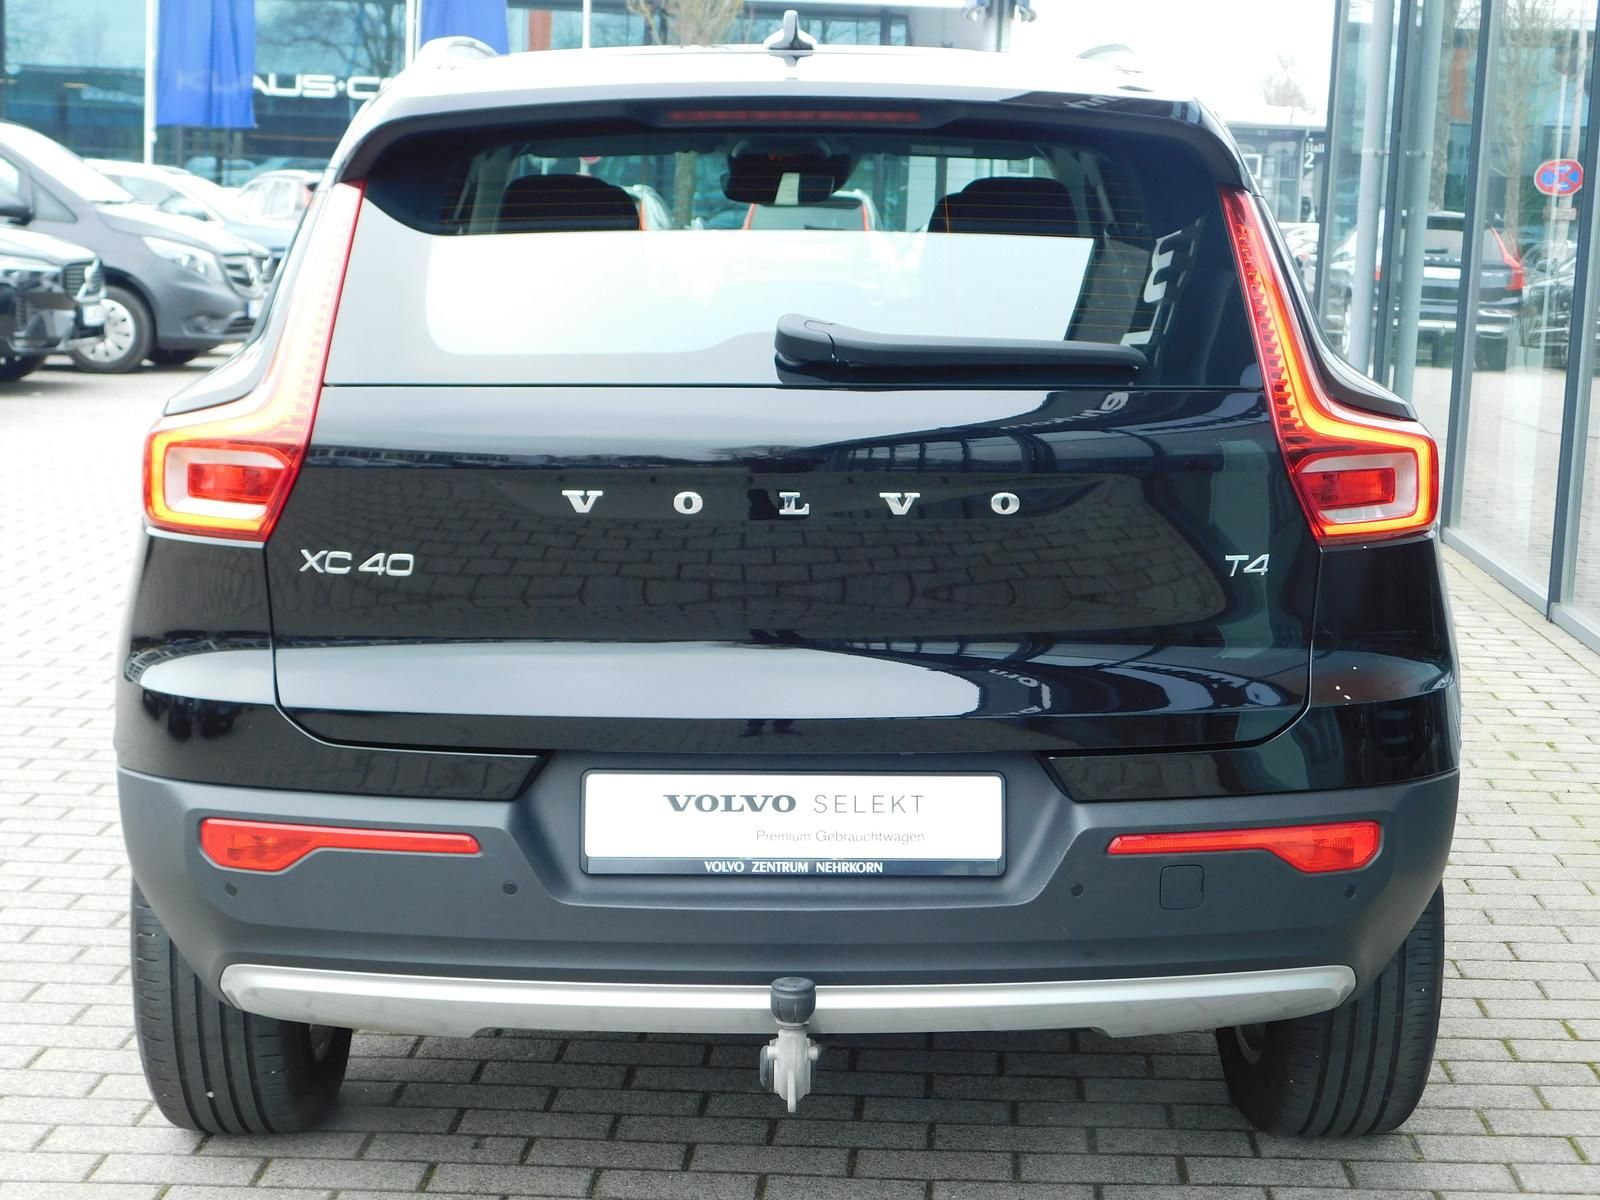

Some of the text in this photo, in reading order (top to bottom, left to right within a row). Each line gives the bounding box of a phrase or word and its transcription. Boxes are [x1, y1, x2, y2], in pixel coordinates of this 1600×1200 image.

[1304, 152, 1315, 169] 2
[561, 490, 1021, 516] VOLVO
[1225, 553, 1270, 577] T4
[663, 794, 924, 814] VOLVO SELEKT
[756, 830, 926, 845] Premium Gebrauchtwagen
[704, 860, 883, 874] VOLVO ZENTRUM NEHRKORN
